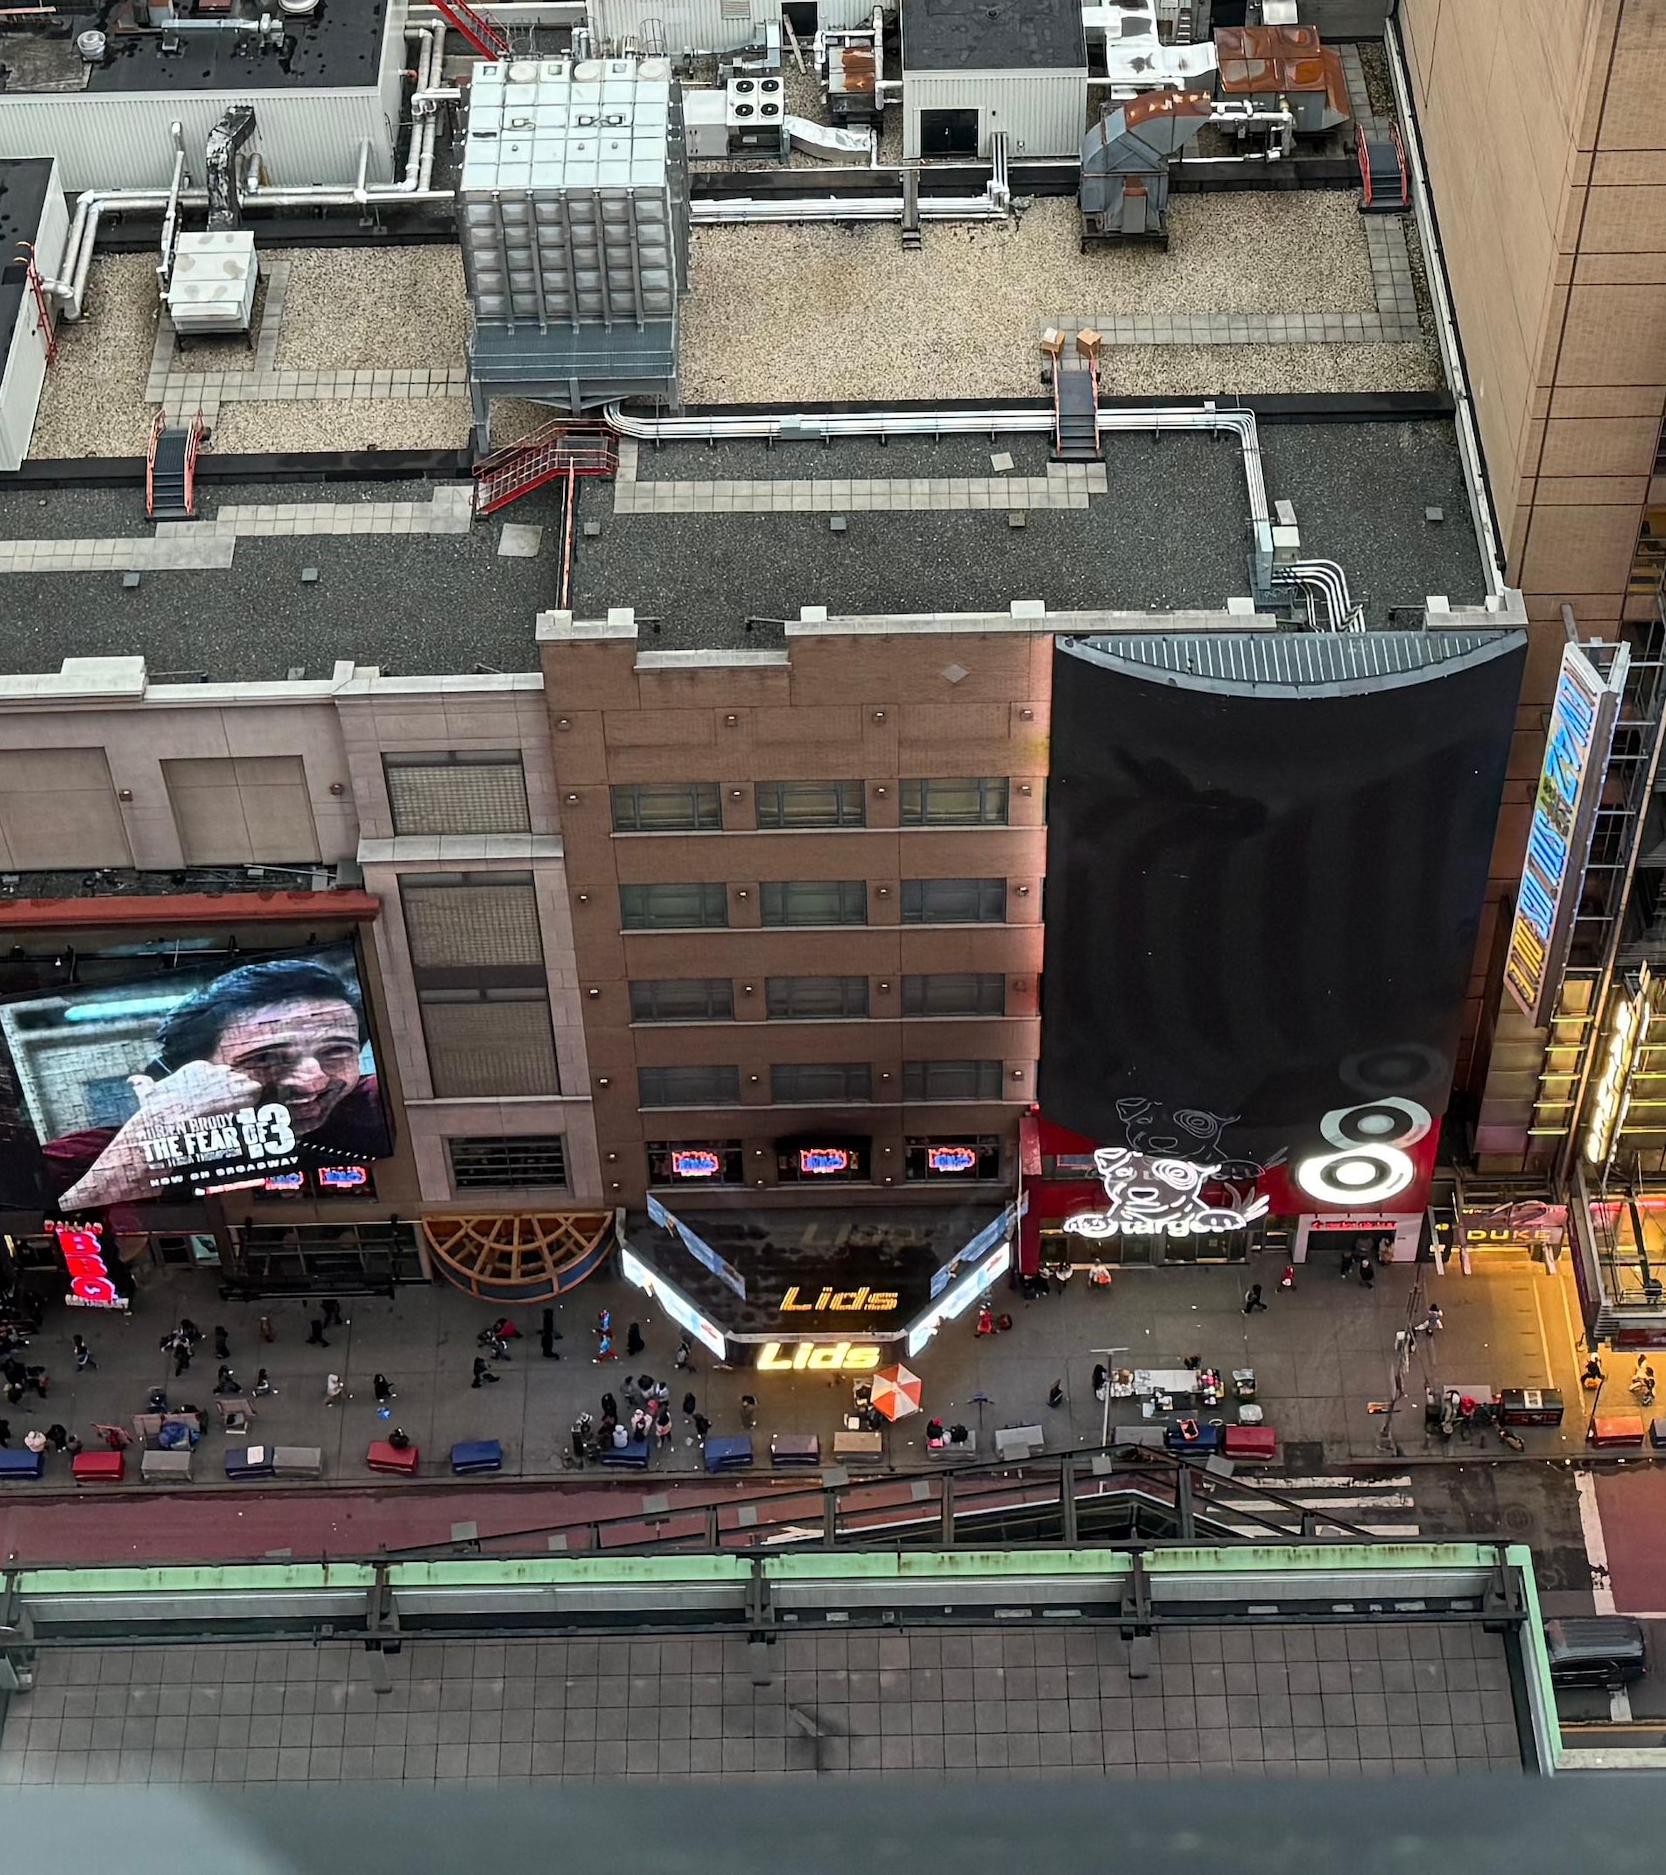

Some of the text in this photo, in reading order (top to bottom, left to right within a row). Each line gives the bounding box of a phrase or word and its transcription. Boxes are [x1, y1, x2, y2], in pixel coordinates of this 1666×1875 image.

[143, 1137, 181, 1162] THE
[183, 1125, 240, 1155] FEAR
[150, 1156, 299, 1186] NOW ON BROADWAY
[1466, 1229, 1551, 1241] DUKE
[780, 1285, 899, 1312] Lids
[756, 1341, 881, 1370] Lids
